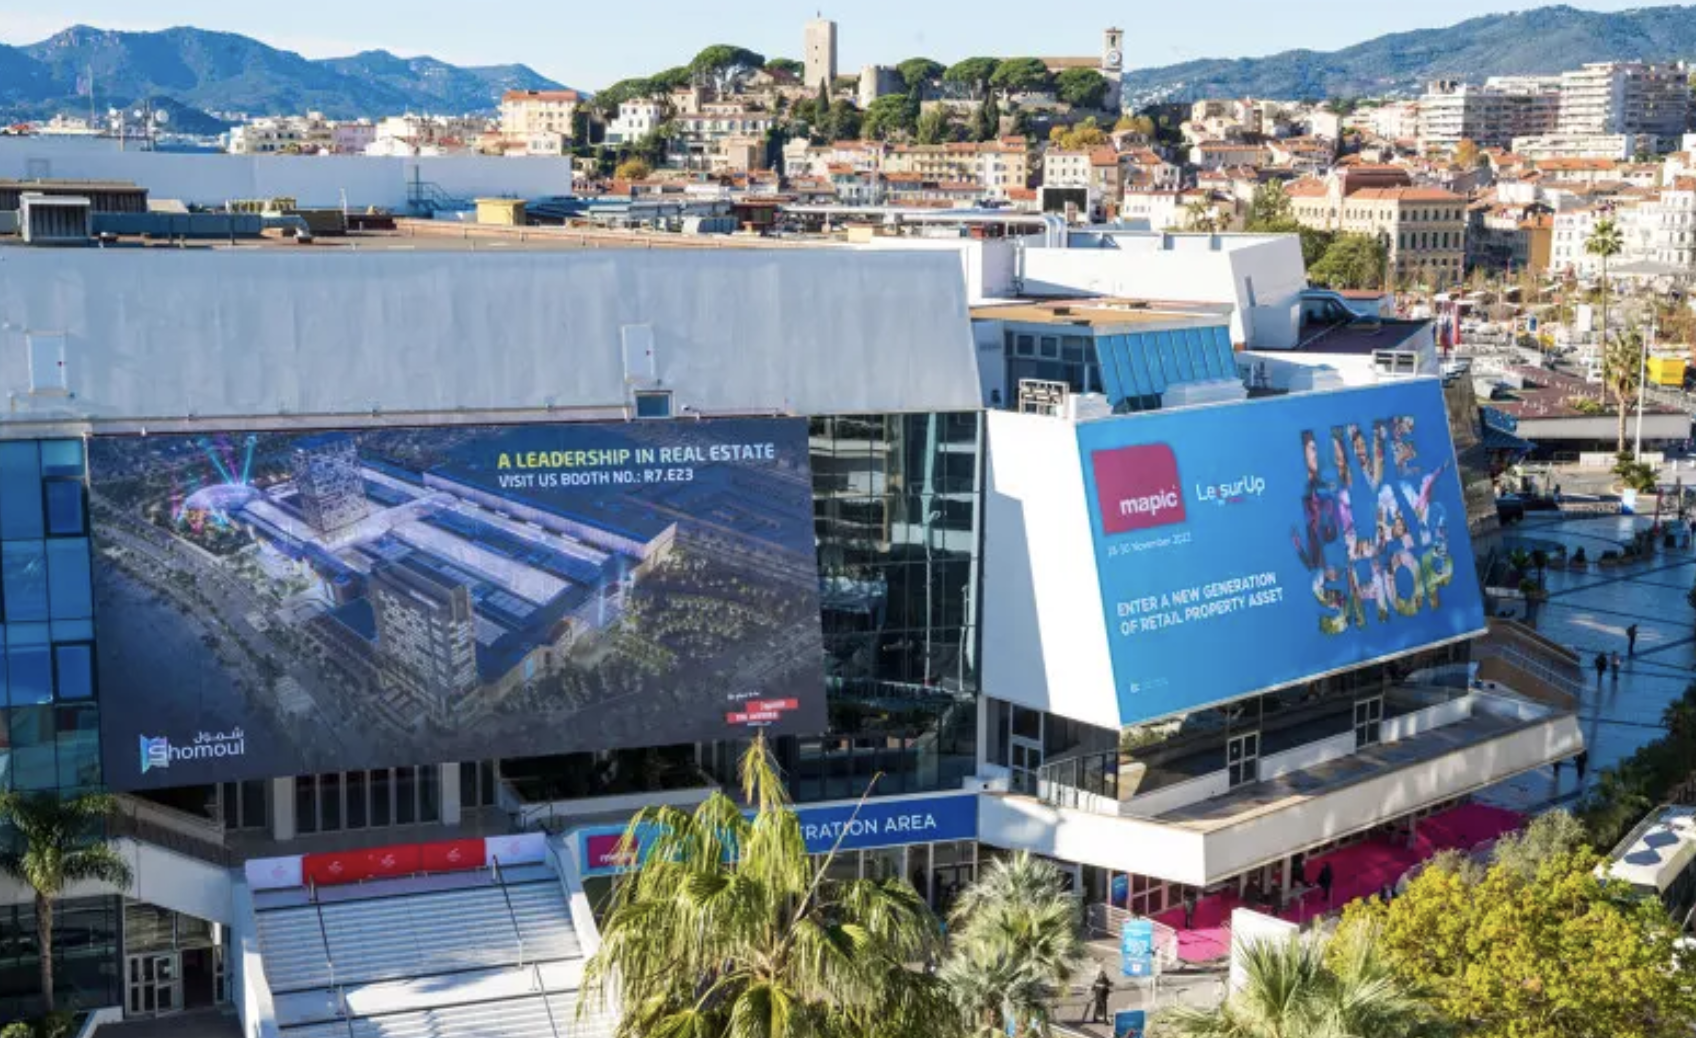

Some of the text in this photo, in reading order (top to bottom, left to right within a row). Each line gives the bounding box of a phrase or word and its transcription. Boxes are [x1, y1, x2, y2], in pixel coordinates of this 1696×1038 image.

[497, 442, 774, 469] A LEADERSHIP IN REAL ESTATE
[1302, 415, 1420, 493] LIVE
[499, 473, 534, 488] VISIT
[538, 472, 558, 487] US
[560, 470, 610, 486] BOOTH
[644, 467, 694, 483] R7.E23
[1119, 489, 1177, 516] mapic
[1117, 572, 1277, 617] ENTER A NEW GENERATION
[1312, 547, 1453, 635] SHOP
[1120, 587, 1283, 636] OF RETAIL PROPERTY ASSET
[148, 738, 244, 761] Shomoul
[799, 813, 937, 841] RATION AREA
